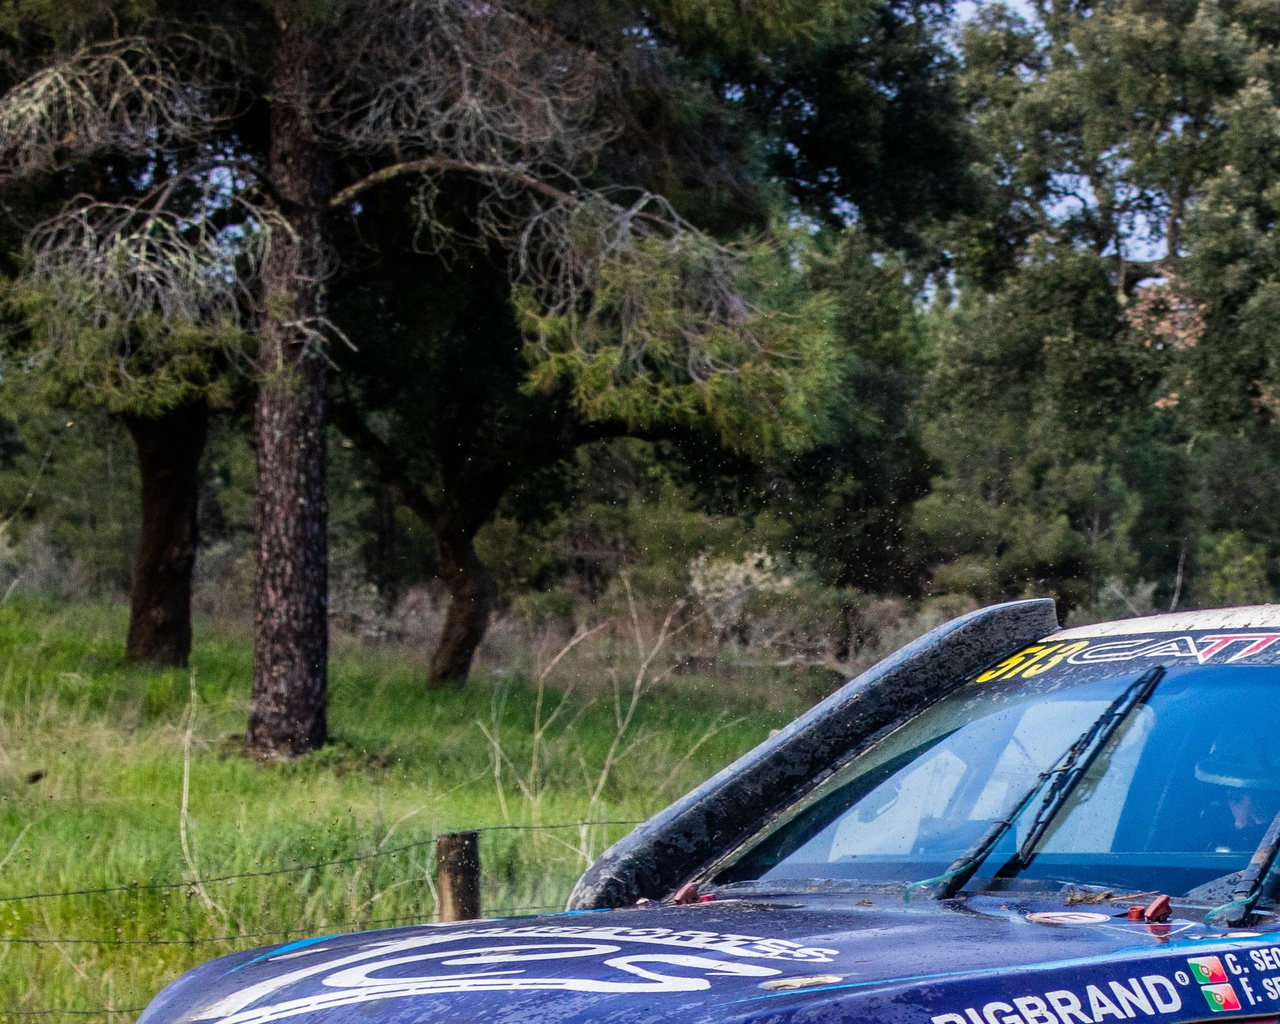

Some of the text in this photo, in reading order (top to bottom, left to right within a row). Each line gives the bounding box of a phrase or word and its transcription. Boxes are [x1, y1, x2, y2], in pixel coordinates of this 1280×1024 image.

[978, 641, 1090, 682] 513
[1224, 955, 1249, 976] C.
[1245, 977, 1262, 1006] F.
